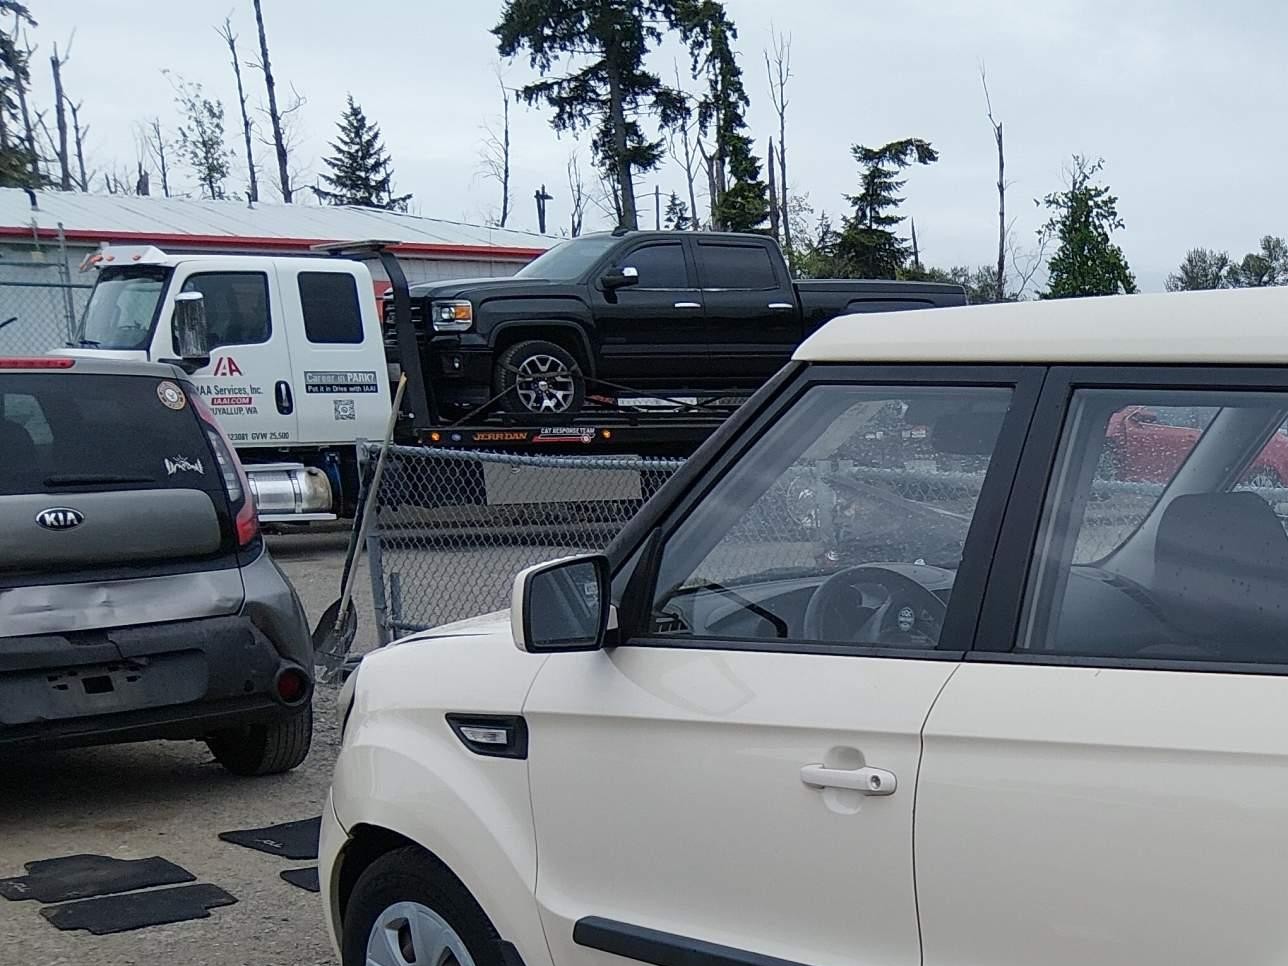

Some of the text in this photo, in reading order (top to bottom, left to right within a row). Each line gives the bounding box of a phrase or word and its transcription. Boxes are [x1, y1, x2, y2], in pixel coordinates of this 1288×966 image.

[214, 357, 243, 376] IAA
[214, 384, 250, 396] Services,
[250, 384, 264, 395] Inc.
[246, 407, 259, 415] WA
[251, 432, 268, 440] GVW
[44, 511, 79, 527] KIA
